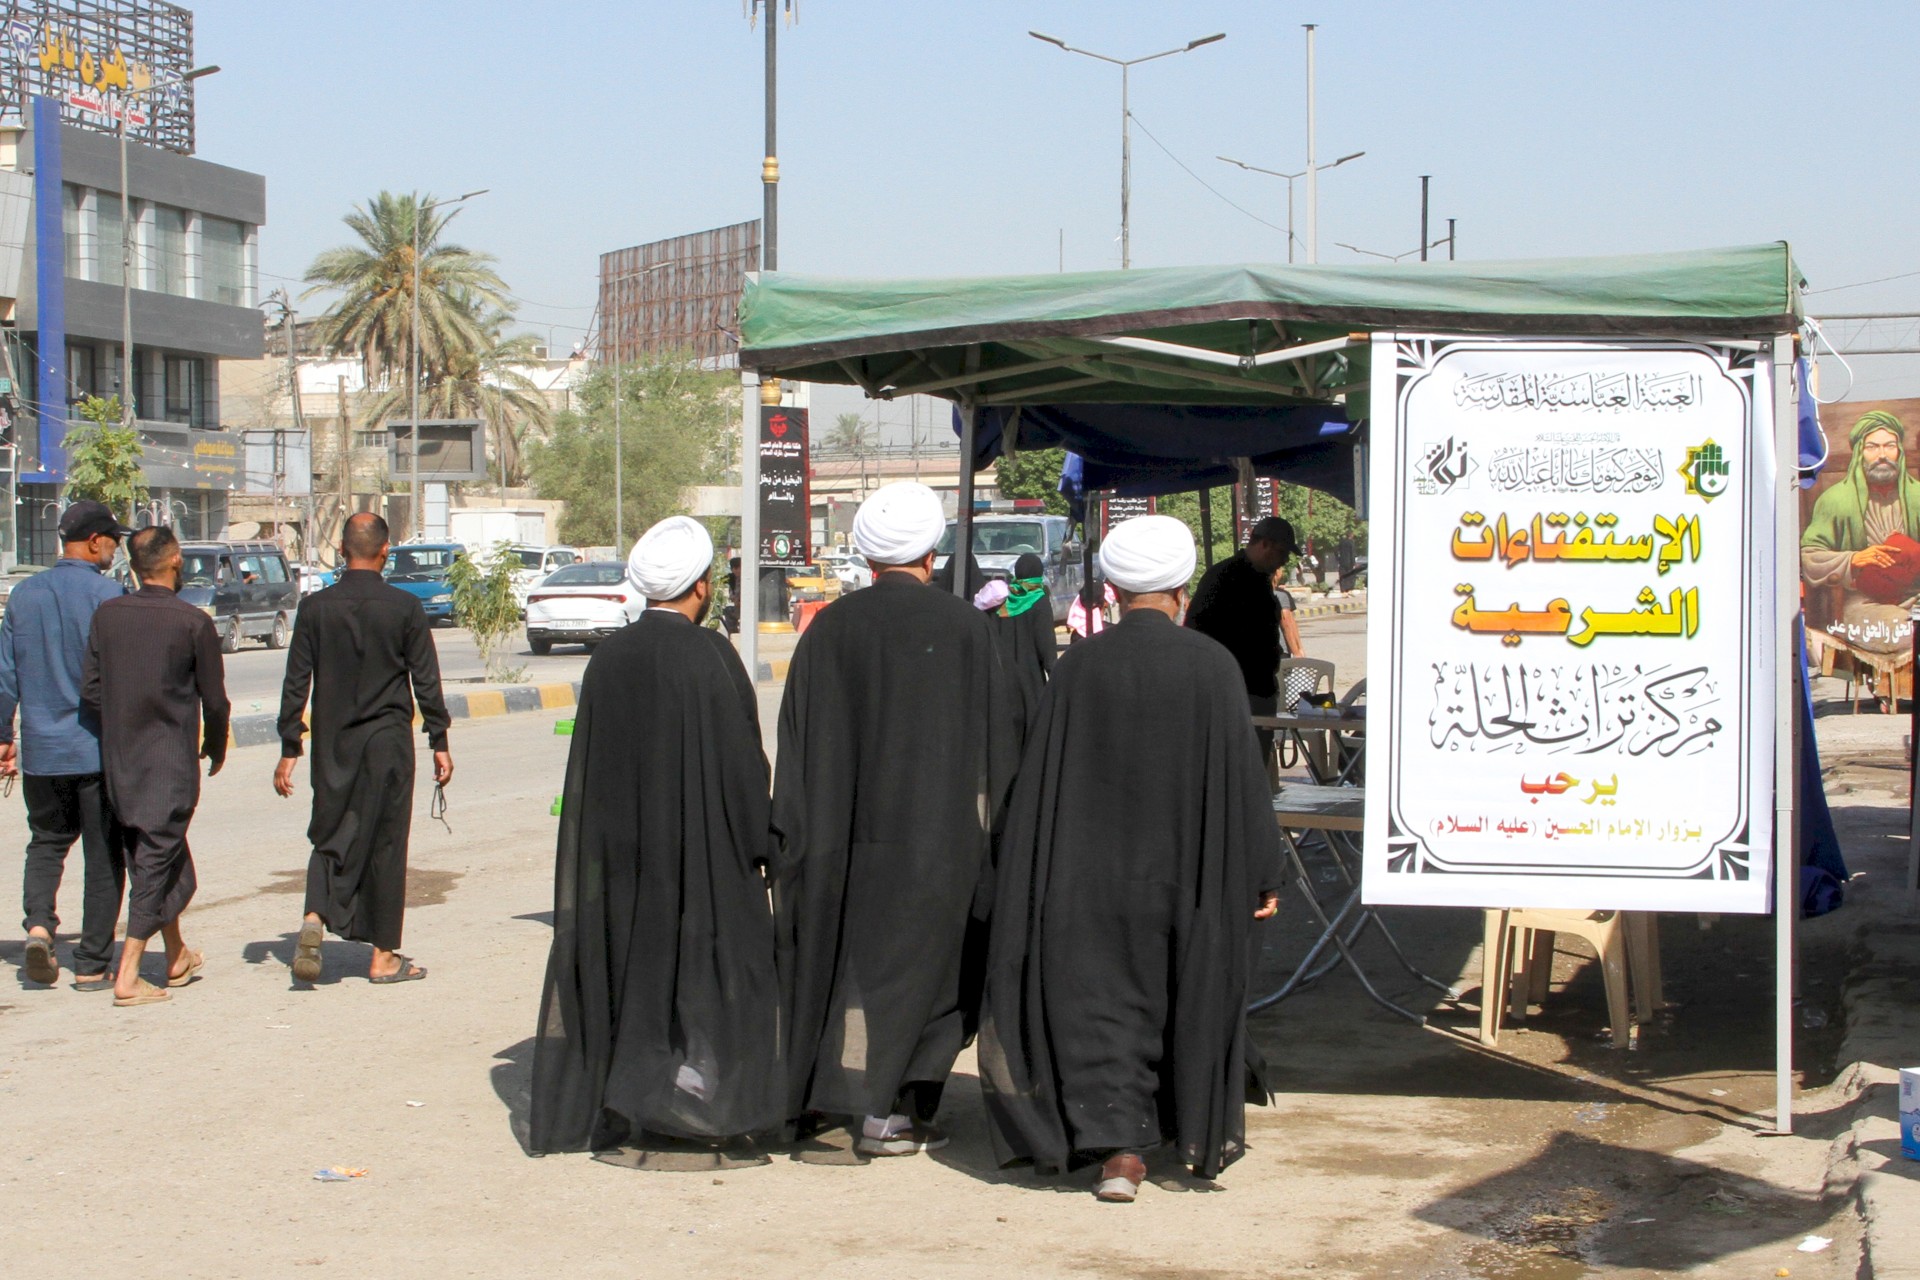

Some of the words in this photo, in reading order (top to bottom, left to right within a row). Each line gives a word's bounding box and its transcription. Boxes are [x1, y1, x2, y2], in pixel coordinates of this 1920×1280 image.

[1453, 372, 1541, 413] المقدسة
[1535, 371, 1640, 413] العباسية
[1632, 371, 1703, 413] العتبة
[1452, 512, 1699, 574] الإستفتاءات
[1453, 584, 1698, 647] الشرعية
[1848, 623, 1861, 641] مع
[1863, 619, 1890, 643] والحق
[1428, 662, 1536, 752] الحلة
[1525, 664, 1636, 755] تراث
[1628, 664, 1723, 757] مركز
[1520, 772, 1619, 806] يرحب
[1544, 818, 1600, 839] الحسين
[1657, 819, 1702, 842] بزوار
